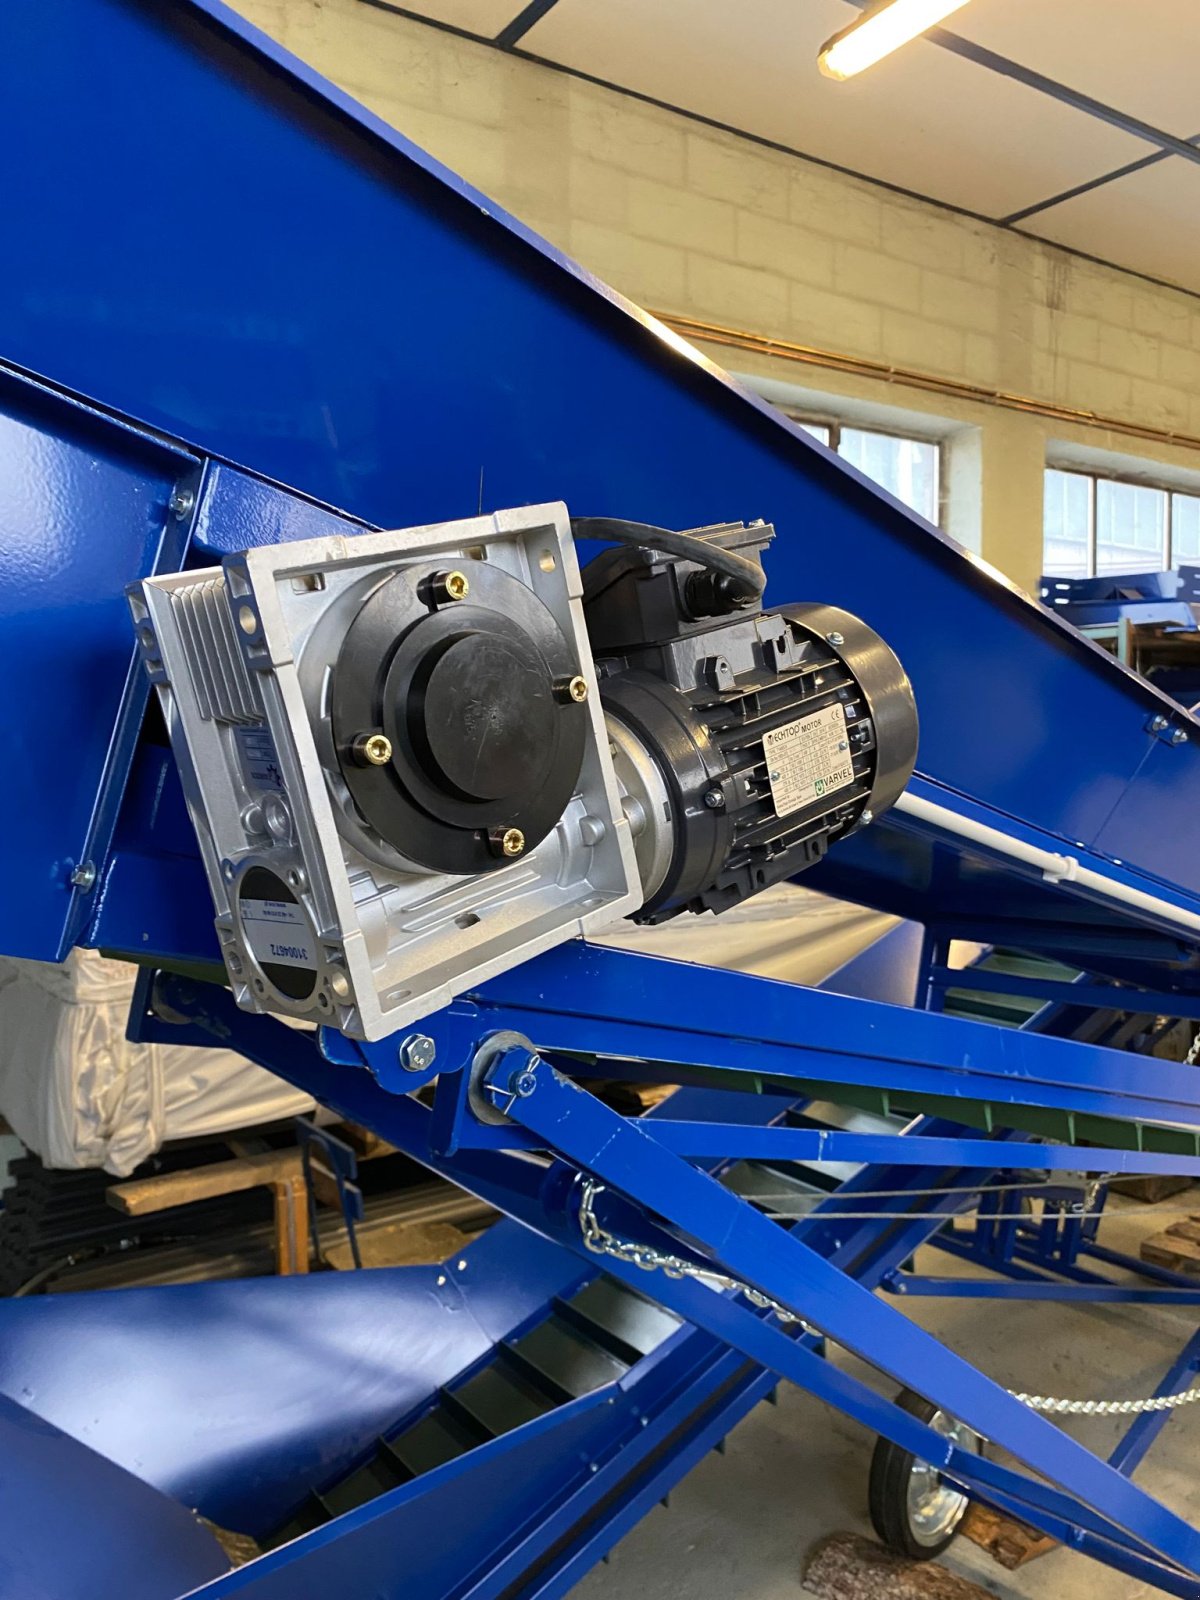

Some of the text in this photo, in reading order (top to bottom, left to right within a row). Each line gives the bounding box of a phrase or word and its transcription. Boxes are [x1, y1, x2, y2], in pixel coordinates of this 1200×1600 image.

[801, 718, 822, 733] MOTOR
[823, 768, 852, 787] VARVEL
[270, 943, 308, 960] 31004672
